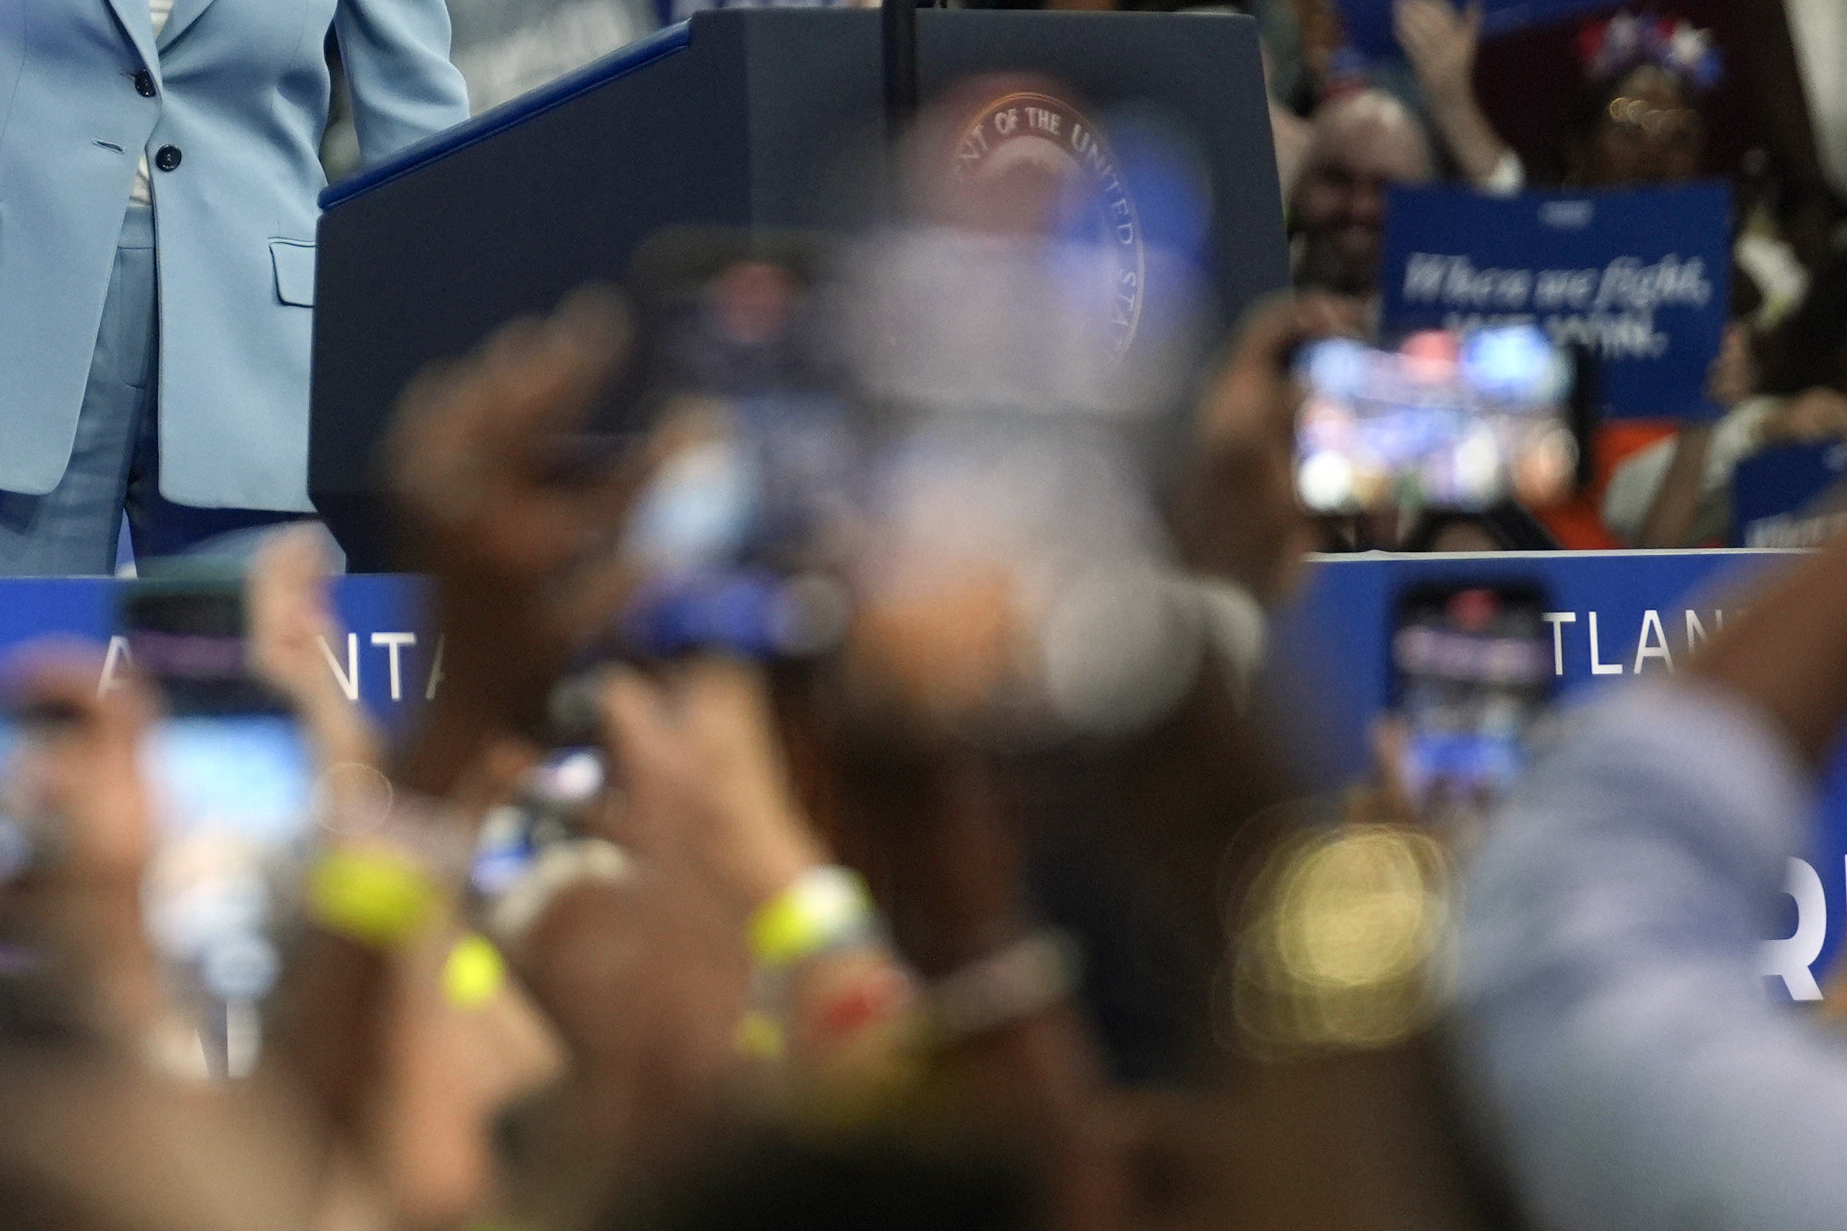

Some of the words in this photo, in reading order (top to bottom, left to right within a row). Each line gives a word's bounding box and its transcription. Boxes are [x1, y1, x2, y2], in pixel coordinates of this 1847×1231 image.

[994, 108, 1019, 136] OF
[1025, 107, 1061, 136] THE
[1403, 251, 1532, 308] When
[1533, 268, 1599, 311] we
